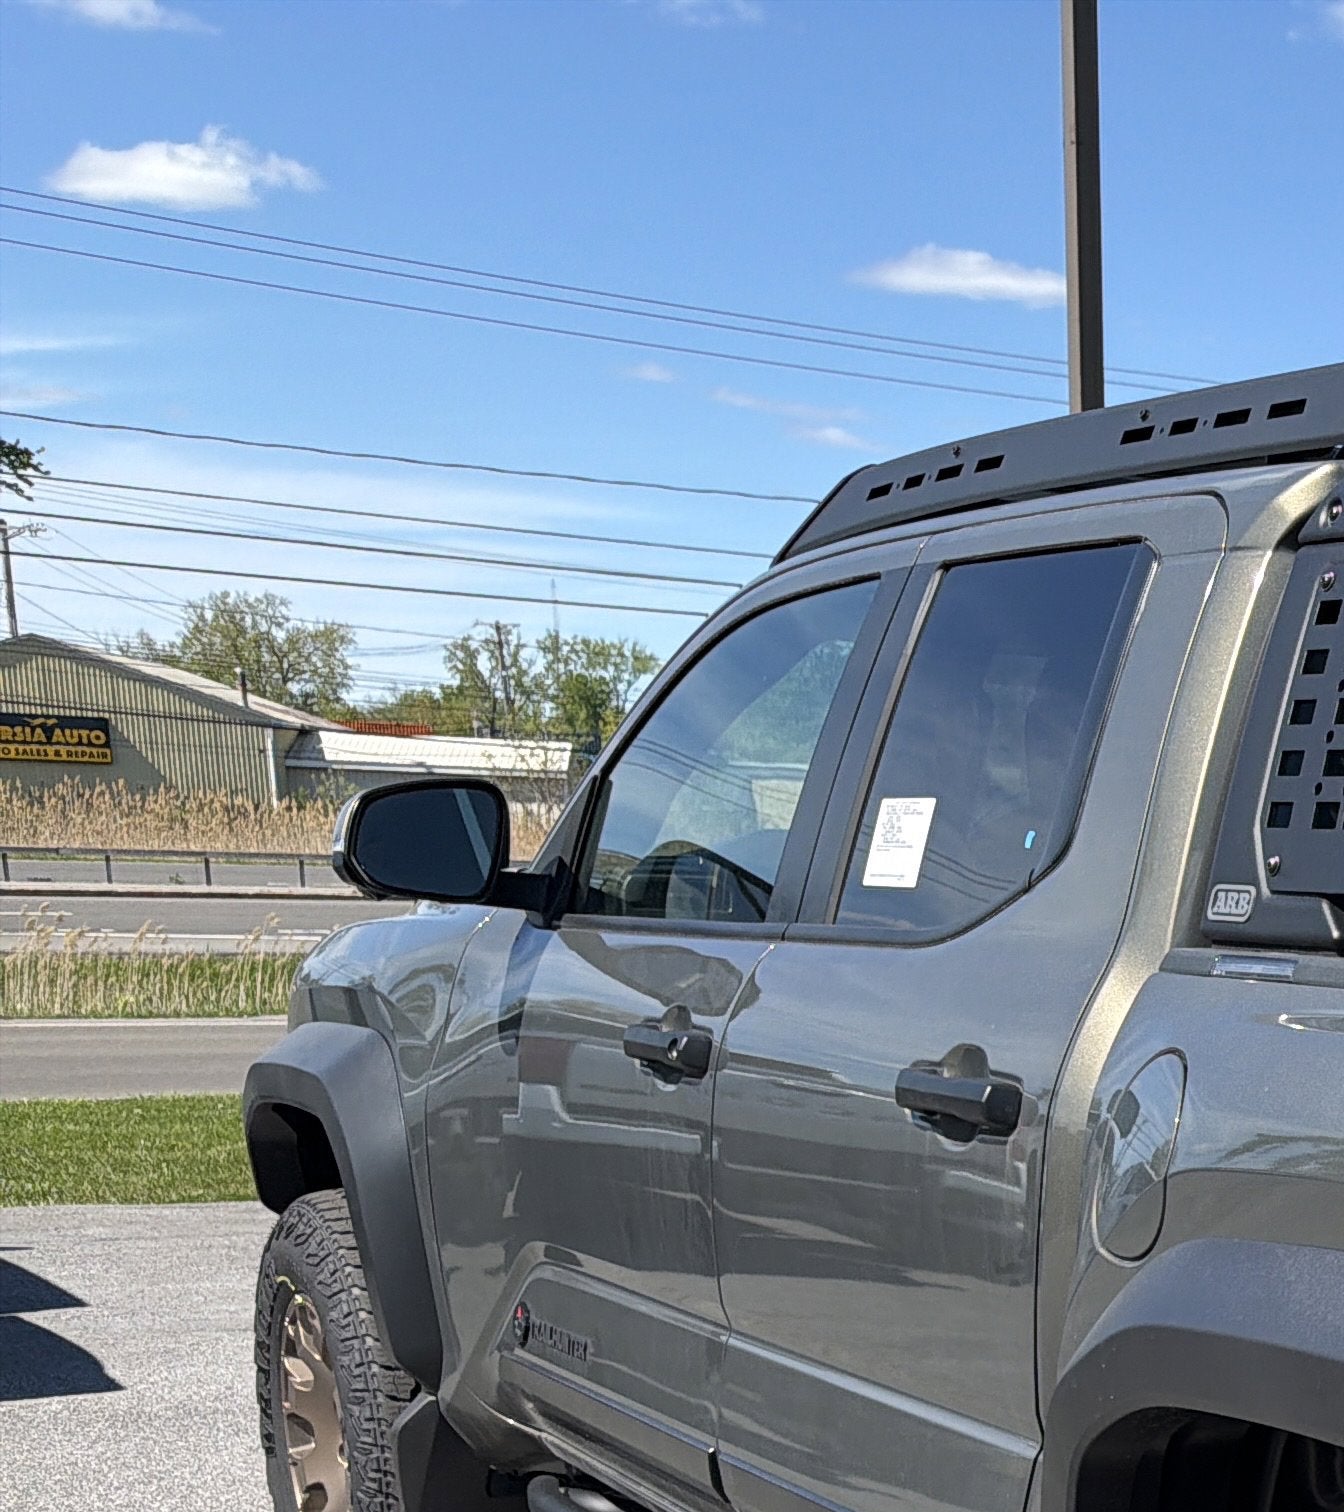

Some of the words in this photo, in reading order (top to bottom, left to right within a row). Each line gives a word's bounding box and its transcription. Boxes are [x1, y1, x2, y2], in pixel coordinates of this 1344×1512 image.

[51, 727, 107, 745] AUTO
[14, 746, 50, 758] SALES
[53, 749, 63, 758] &
[65, 749, 109, 760] REPAIR
[1212, 891, 1251, 915] ARB
